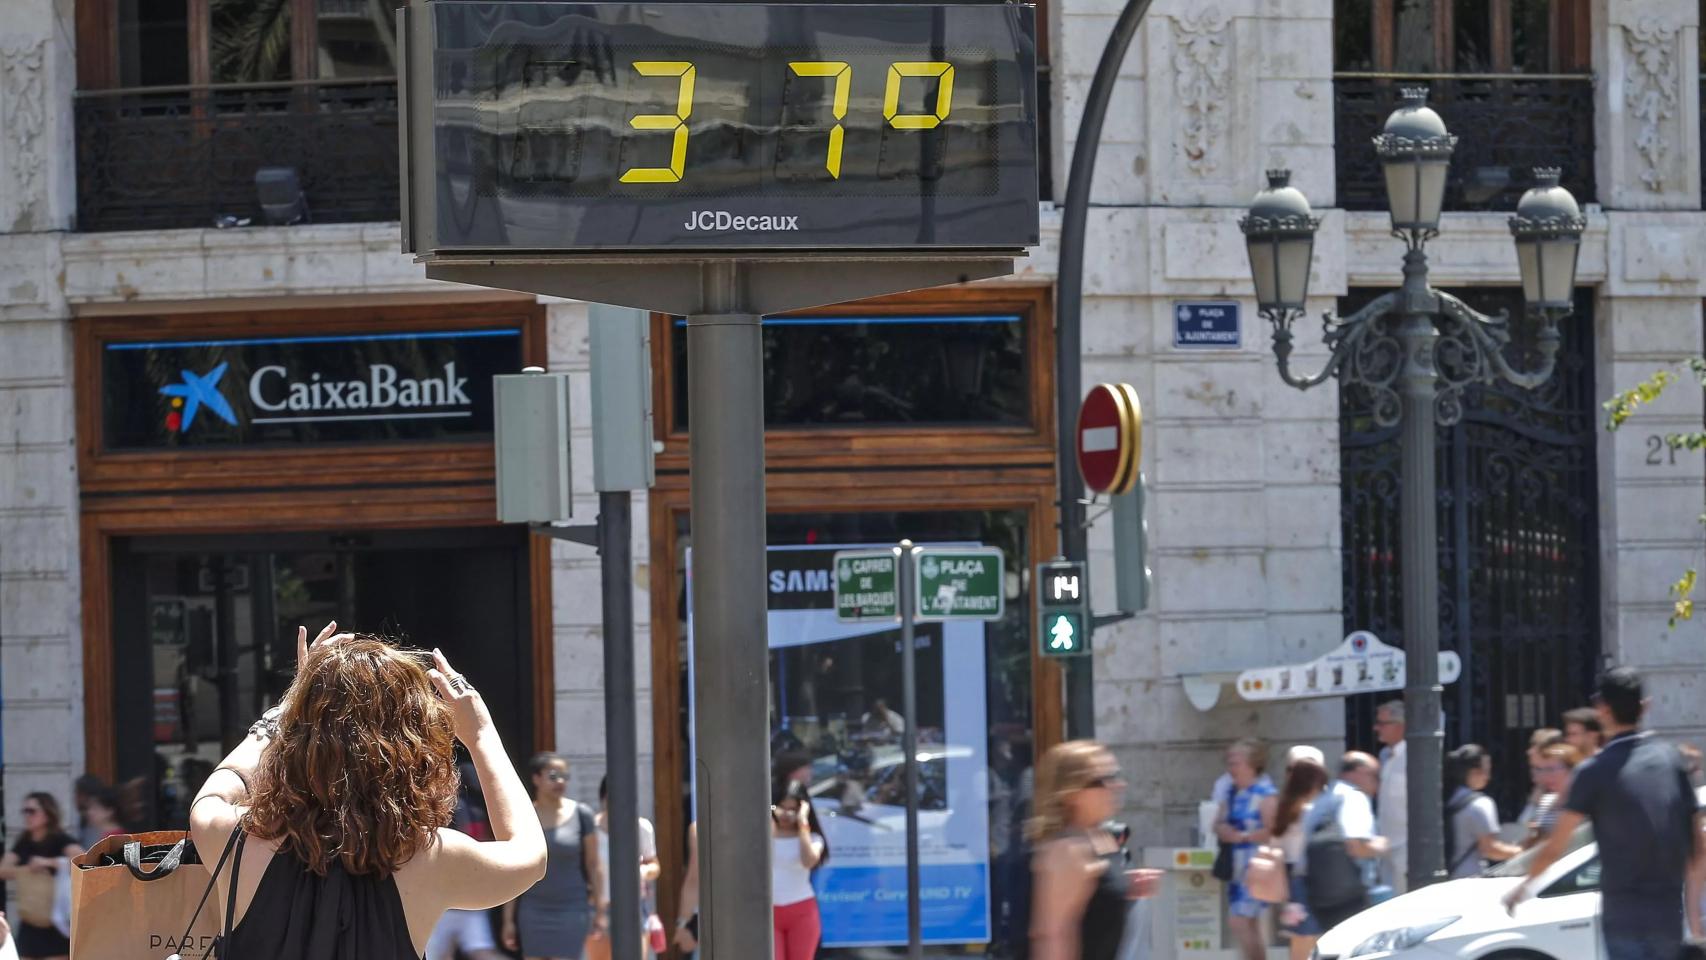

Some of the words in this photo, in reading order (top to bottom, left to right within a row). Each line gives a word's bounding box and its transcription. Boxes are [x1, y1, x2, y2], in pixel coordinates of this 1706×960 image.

[684, 211, 799, 232] JCDecaux
[250, 361, 471, 411] CaixaBank
[940, 560, 984, 578] PLAÇA
[860, 577, 872, 589] DE
[1054, 576, 1079, 599] 14
[150, 935, 213, 950] PARF
